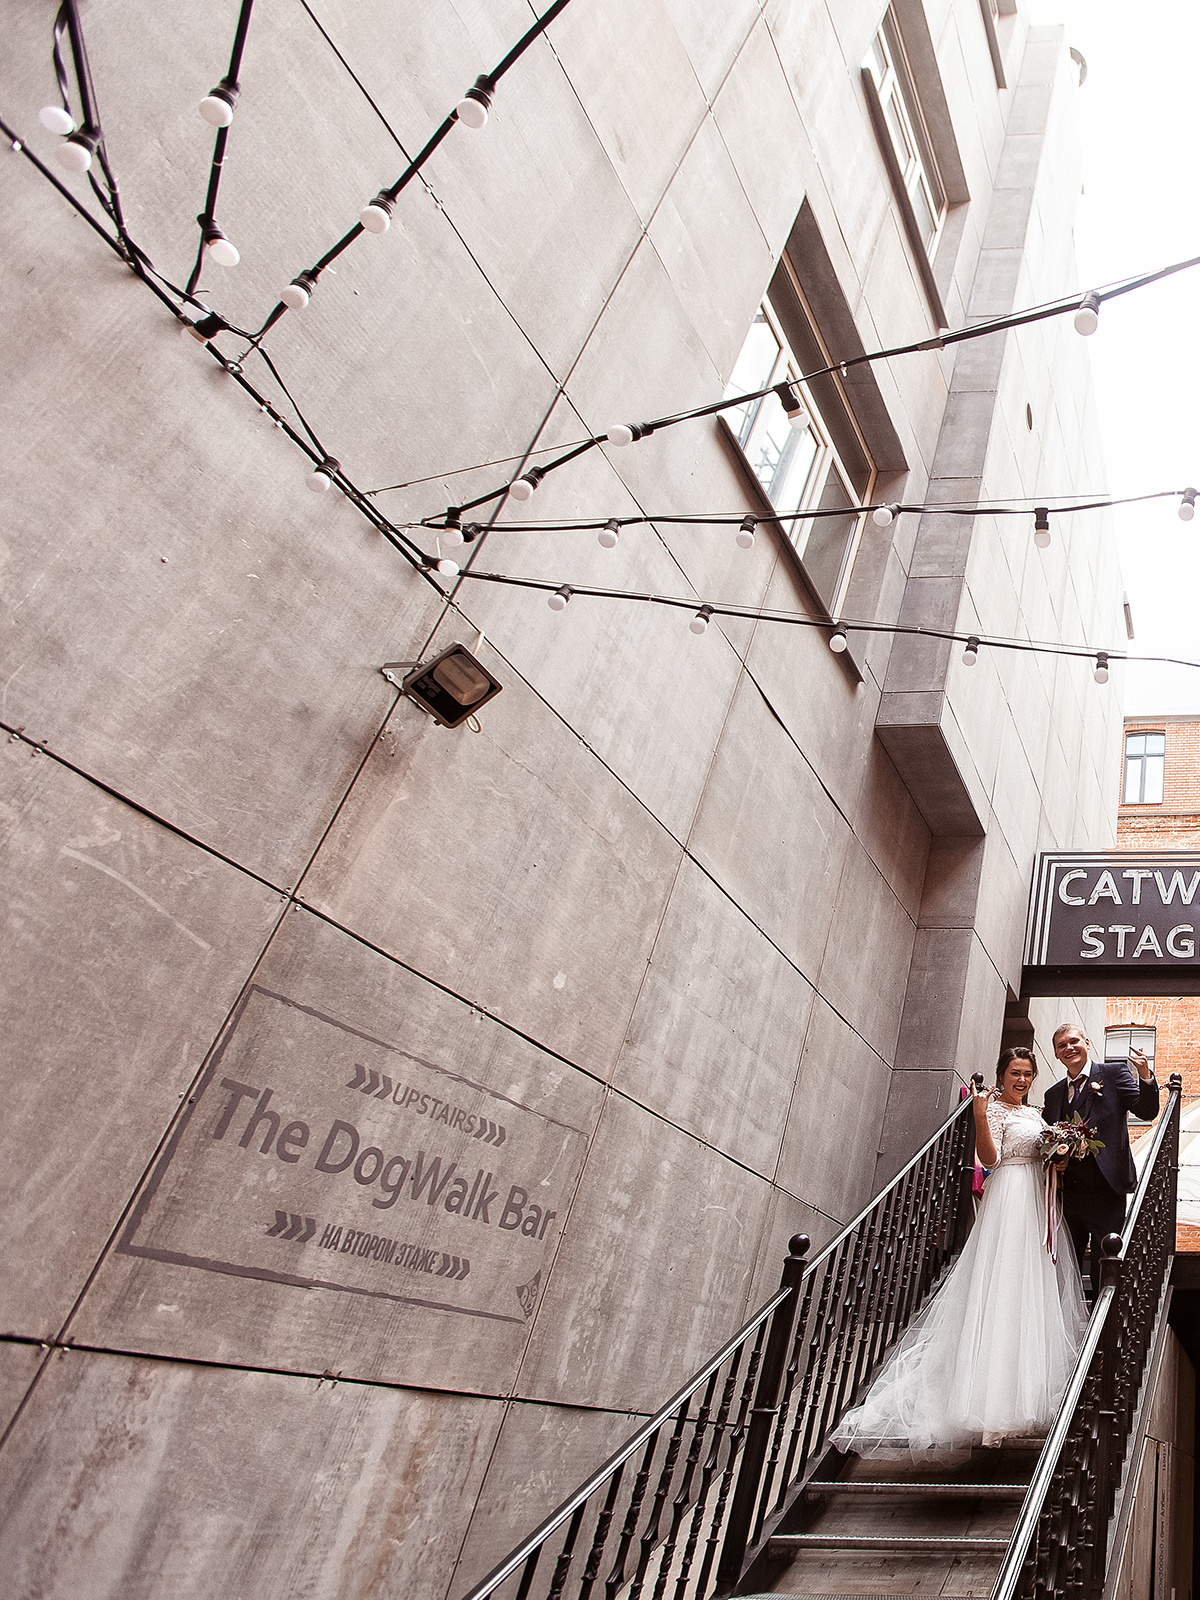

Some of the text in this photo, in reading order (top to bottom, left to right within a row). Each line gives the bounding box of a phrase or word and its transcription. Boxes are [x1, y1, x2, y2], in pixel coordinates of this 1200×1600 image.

[392, 1082, 477, 1134] UPSTAIRS
[212, 1077, 557, 1240] The DogWalk Bar
[318, 1223, 439, 1273] НА ВТОРОМ ЭТАЖЕ
